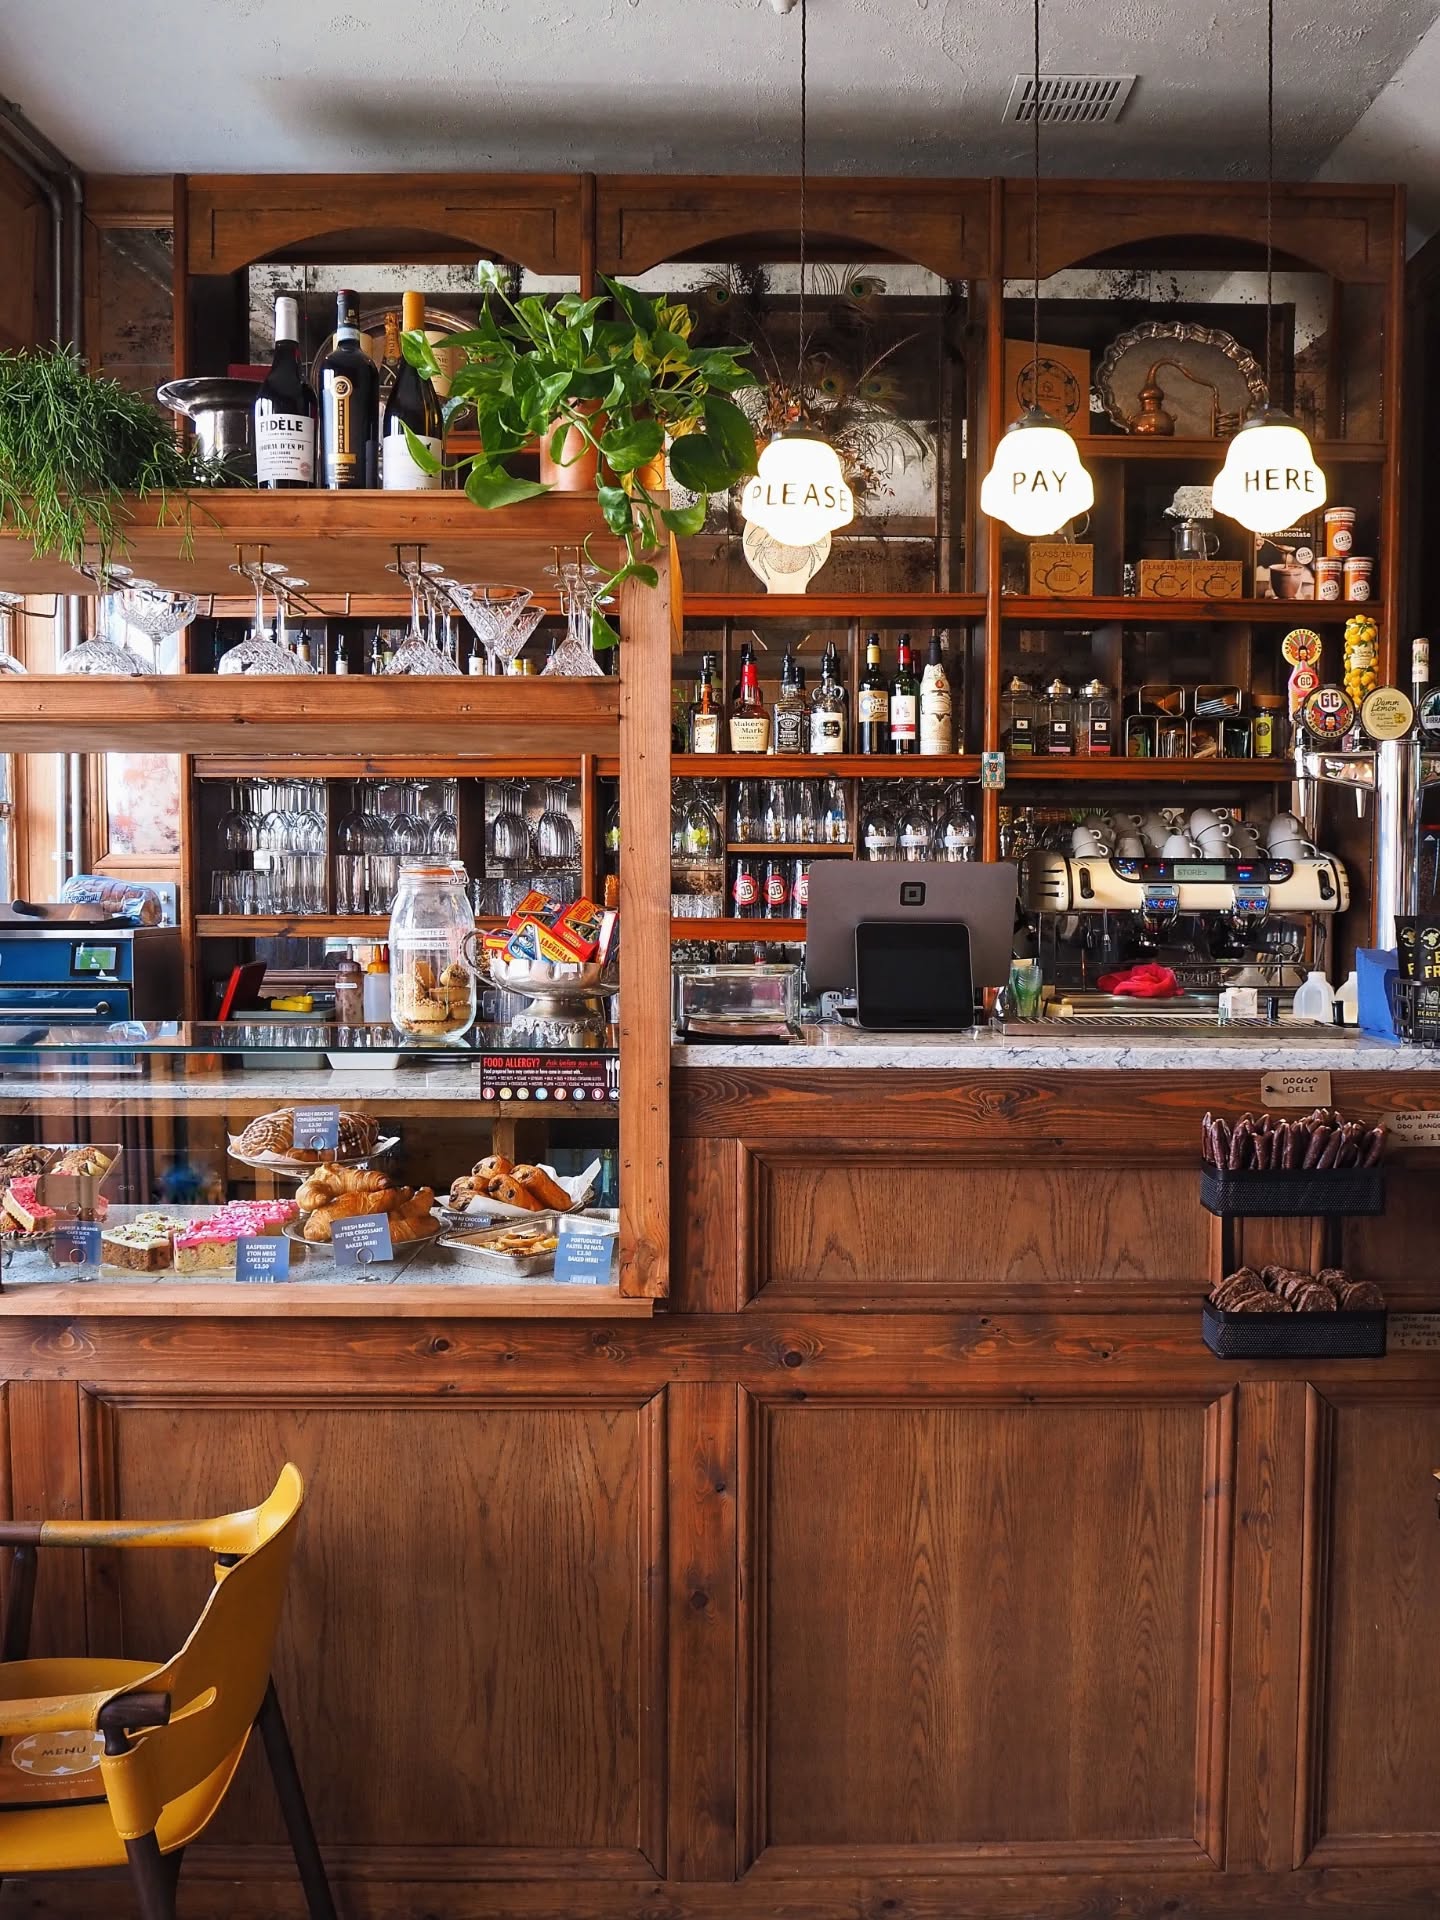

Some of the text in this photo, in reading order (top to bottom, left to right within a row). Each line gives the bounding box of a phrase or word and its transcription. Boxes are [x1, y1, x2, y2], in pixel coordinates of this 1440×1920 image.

[259, 417, 304, 433] FIDÈLE
[1012, 469, 1068, 494] PAY
[1244, 467, 1315, 493] HERE
[752, 483, 848, 512] PLEASE
[1032, 550, 1093, 560] GLASS TEAPOT
[1300, 676, 1312, 687] GC
[1320, 692, 1340, 709] GC
[1371, 702, 1398, 712] Lemon
[483, 1057, 541, 1068] FOOD ALLERGY?
[1282, 1077, 1318, 1085] DOGGO
[1287, 1086, 1315, 1094] DELI
[1400, 1134, 1408, 1142] 2
[334, 1231, 354, 1239] BUTTER
[570, 1237, 602, 1245] PORTUGUESE
[41, 1745, 87, 1757] MENU
